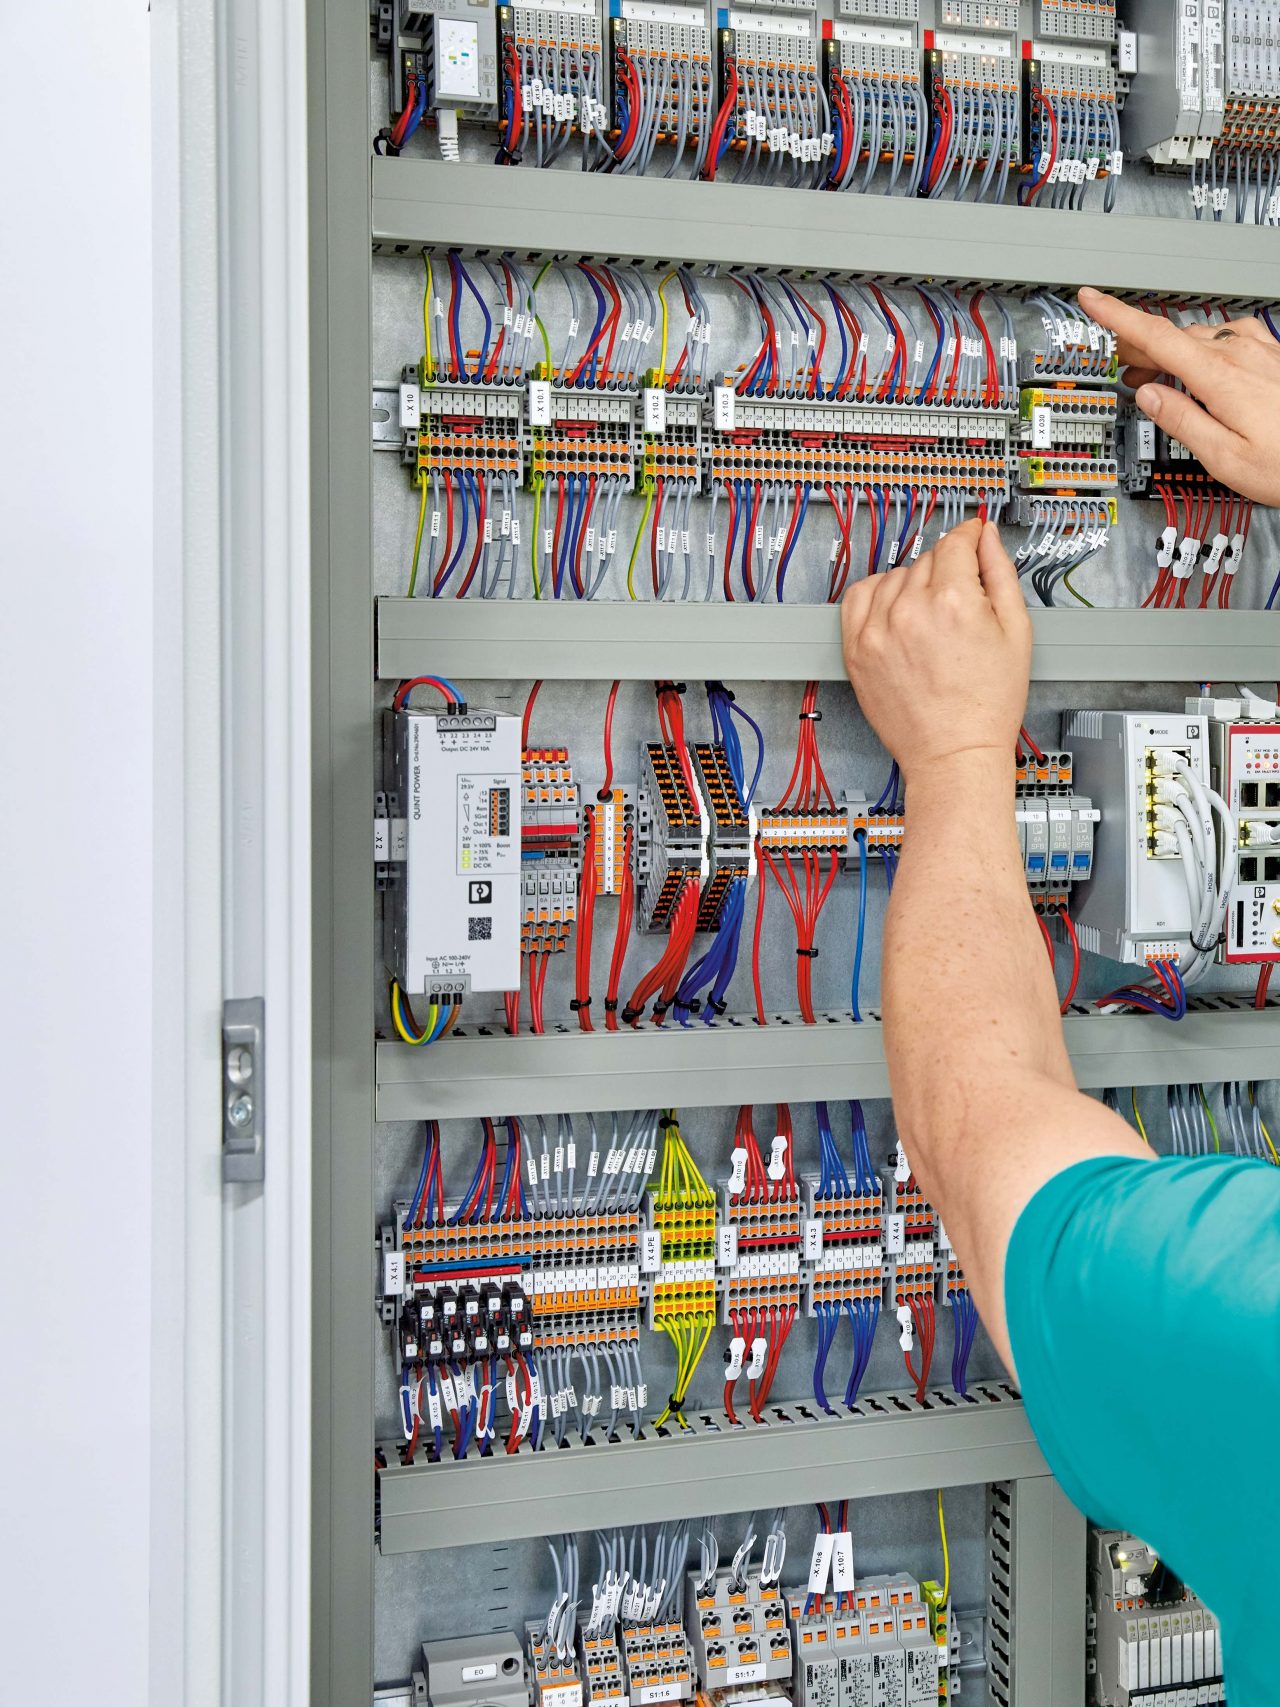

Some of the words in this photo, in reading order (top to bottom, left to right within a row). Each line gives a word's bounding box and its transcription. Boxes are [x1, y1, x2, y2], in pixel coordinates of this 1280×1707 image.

[407, 393, 414, 402] 10
[1144, 430, 1150, 438] 11
[413, 765, 421, 793] POWER
[413, 796, 421, 820] QUINT
[892, 1222, 900, 1233] 4.4
[390, 1261, 398, 1272] 4.1
[735, 1670, 756, 1679] S1:1.7
[649, 1690, 670, 1698] S1:1.6
